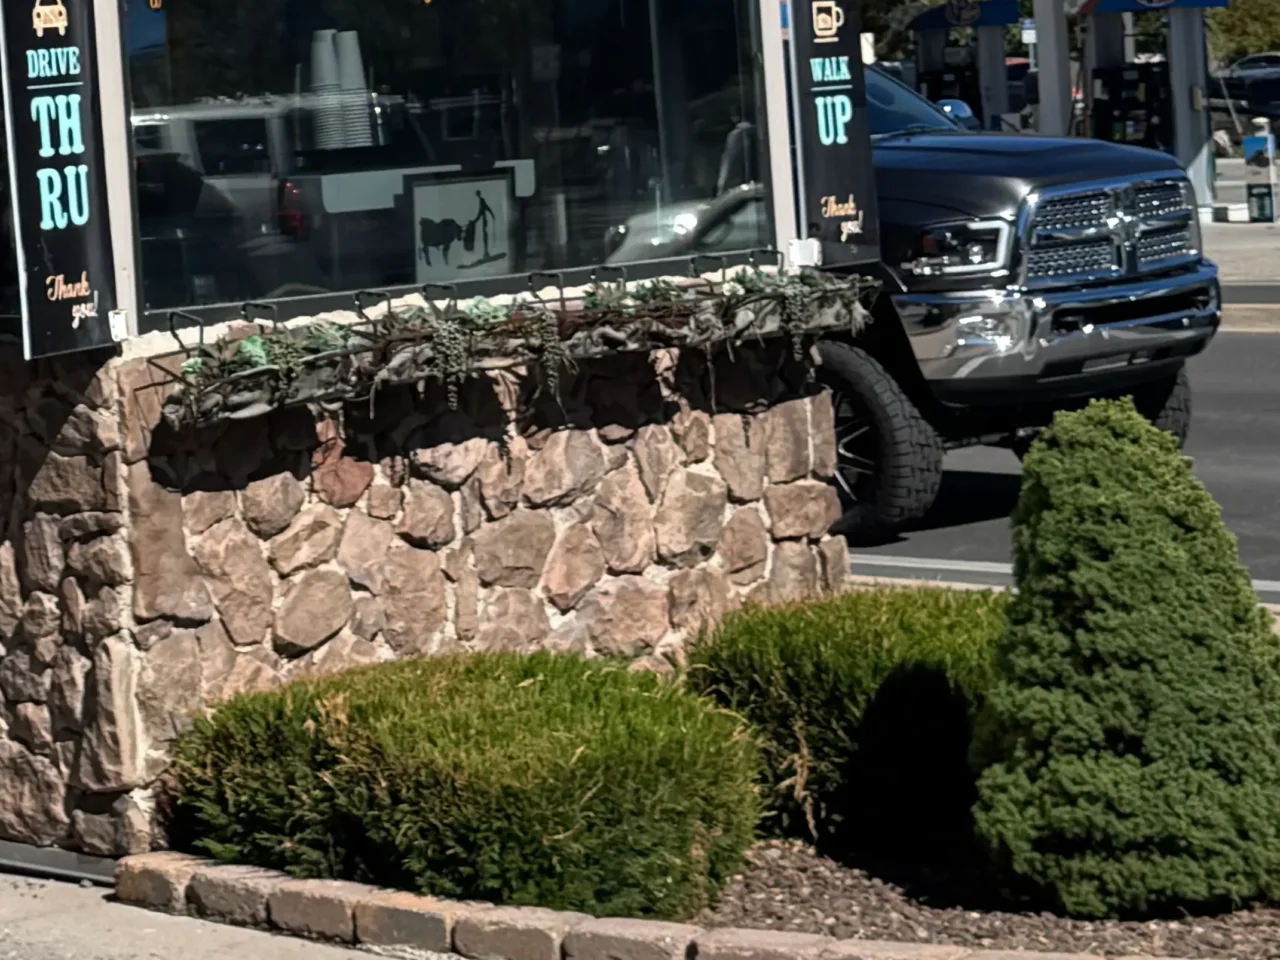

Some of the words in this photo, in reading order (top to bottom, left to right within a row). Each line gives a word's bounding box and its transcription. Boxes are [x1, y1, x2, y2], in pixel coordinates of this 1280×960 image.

[26, 46, 80, 78] DRIVE
[809, 56, 852, 82] WALK
[30, 94, 85, 158] TH
[815, 95, 853, 146] UP
[36, 164, 90, 231] RU
[820, 193, 857, 218] Thank
[45, 270, 91, 301] Thank
